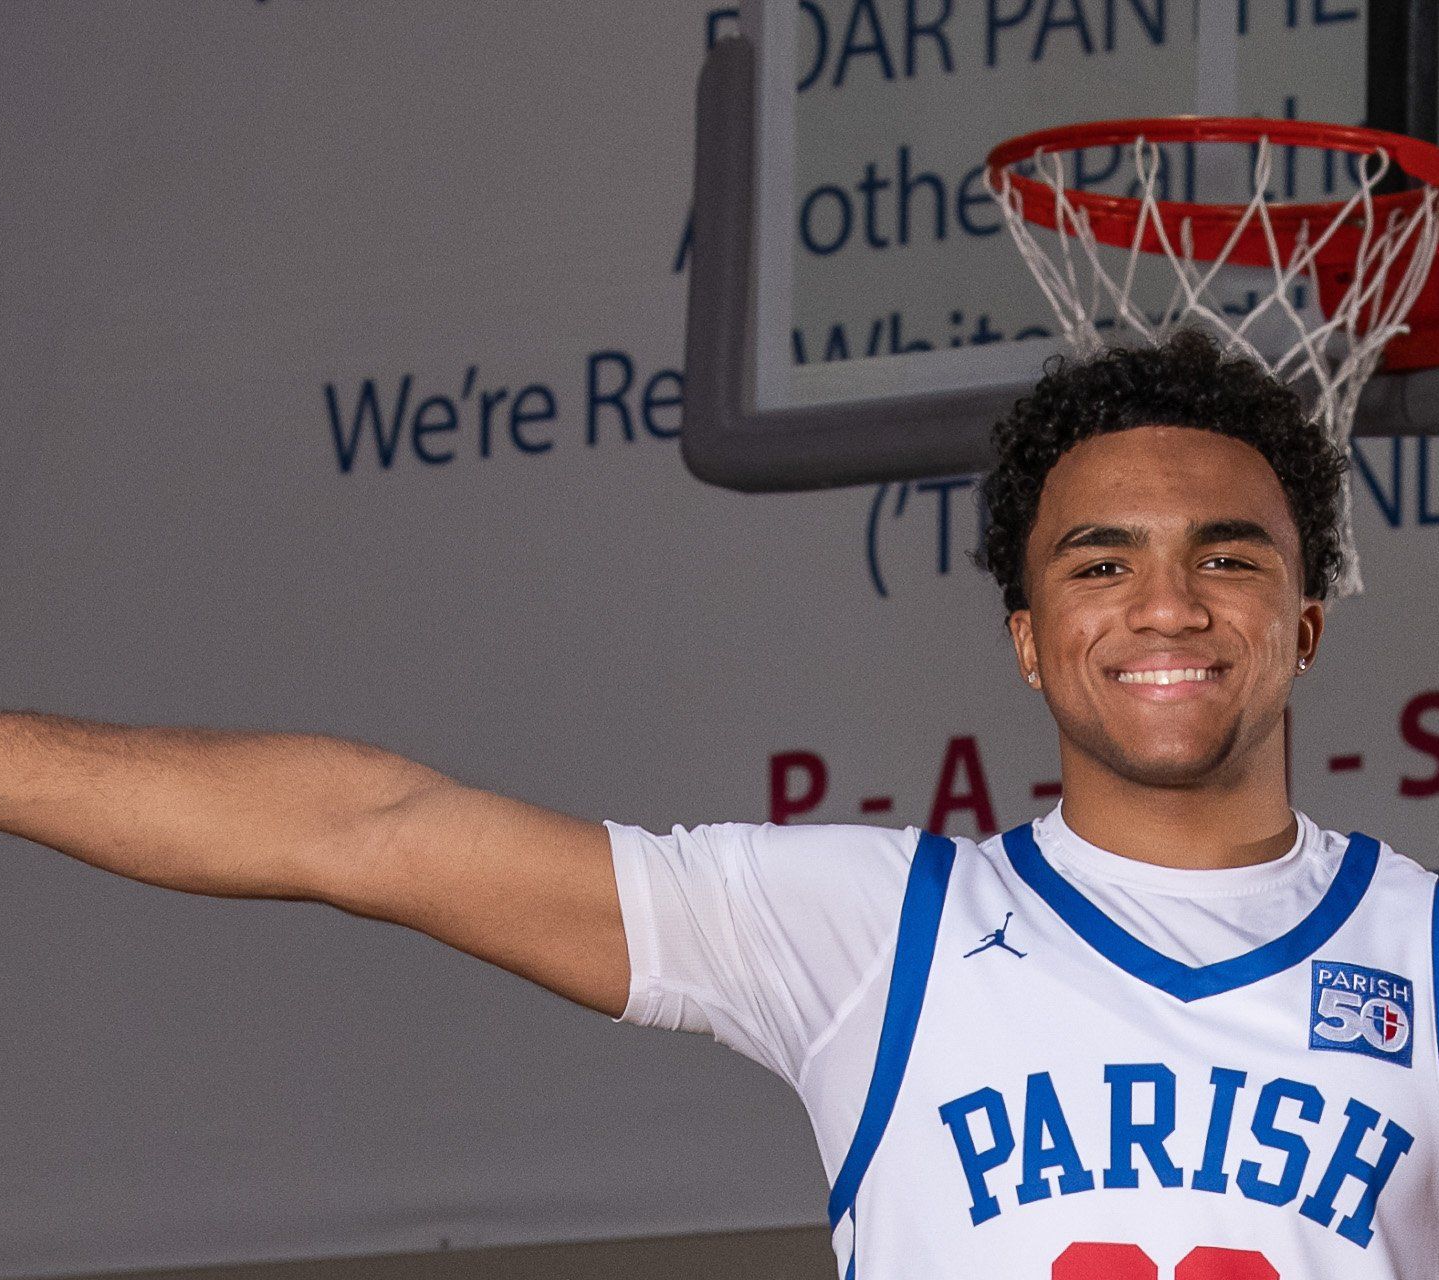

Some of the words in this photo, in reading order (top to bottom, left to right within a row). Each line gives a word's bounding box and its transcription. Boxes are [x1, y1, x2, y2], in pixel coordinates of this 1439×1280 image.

[324, 364, 559, 475] We're
[586, 349, 686, 447] Re
[1313, 988, 1410, 1053] 50
[1318, 969, 1408, 1002] PARISH
[938, 1062, 1415, 1250] PARISH
